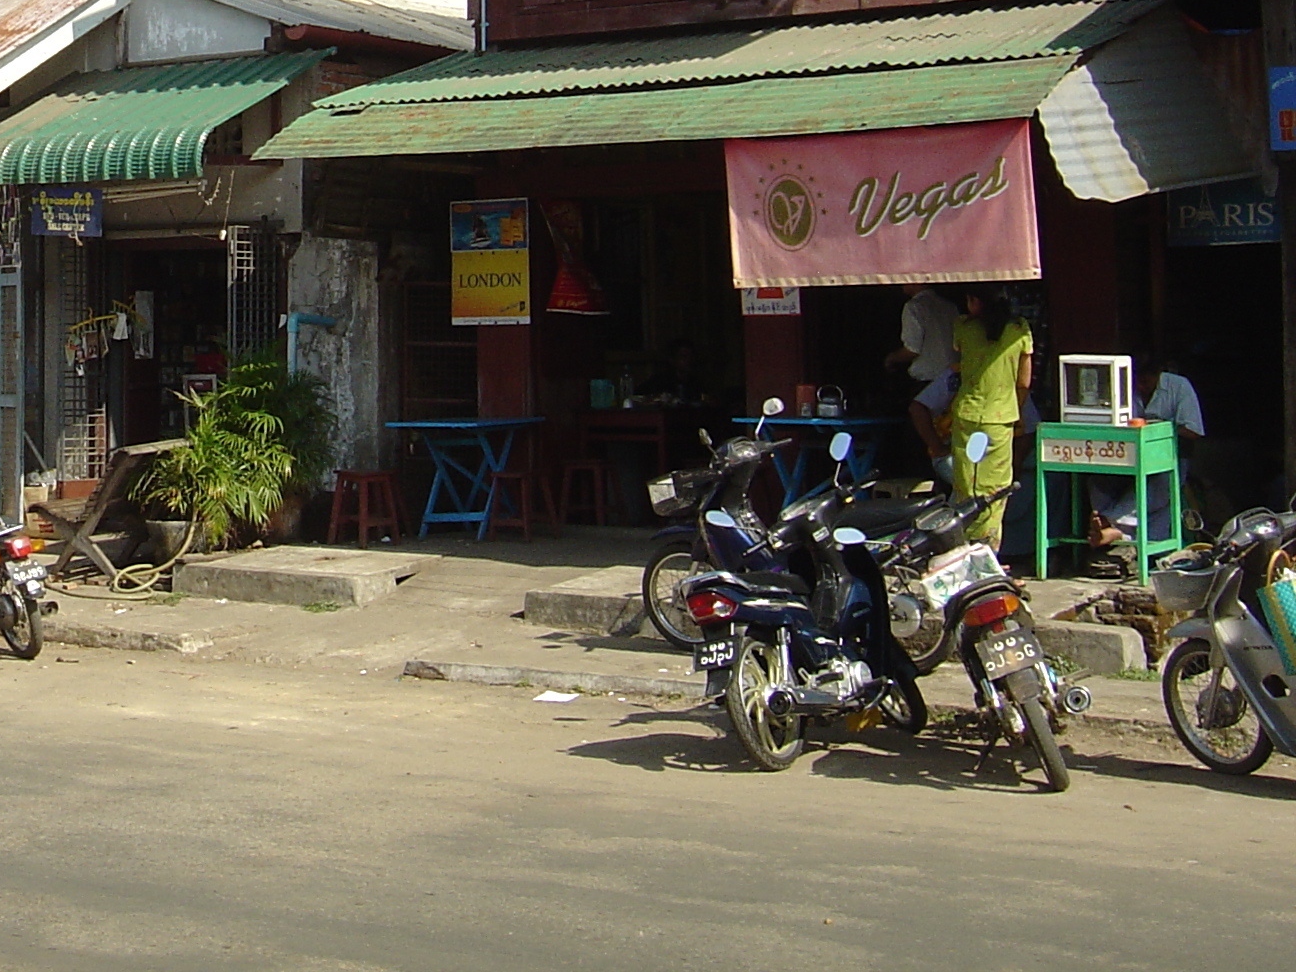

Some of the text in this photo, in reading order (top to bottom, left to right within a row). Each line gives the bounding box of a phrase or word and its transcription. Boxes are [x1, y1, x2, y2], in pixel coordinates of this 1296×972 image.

[849, 156, 1009, 241] Vegas
[1179, 194, 1274, 228] PARIS
[459, 272, 522, 289] LONDON
